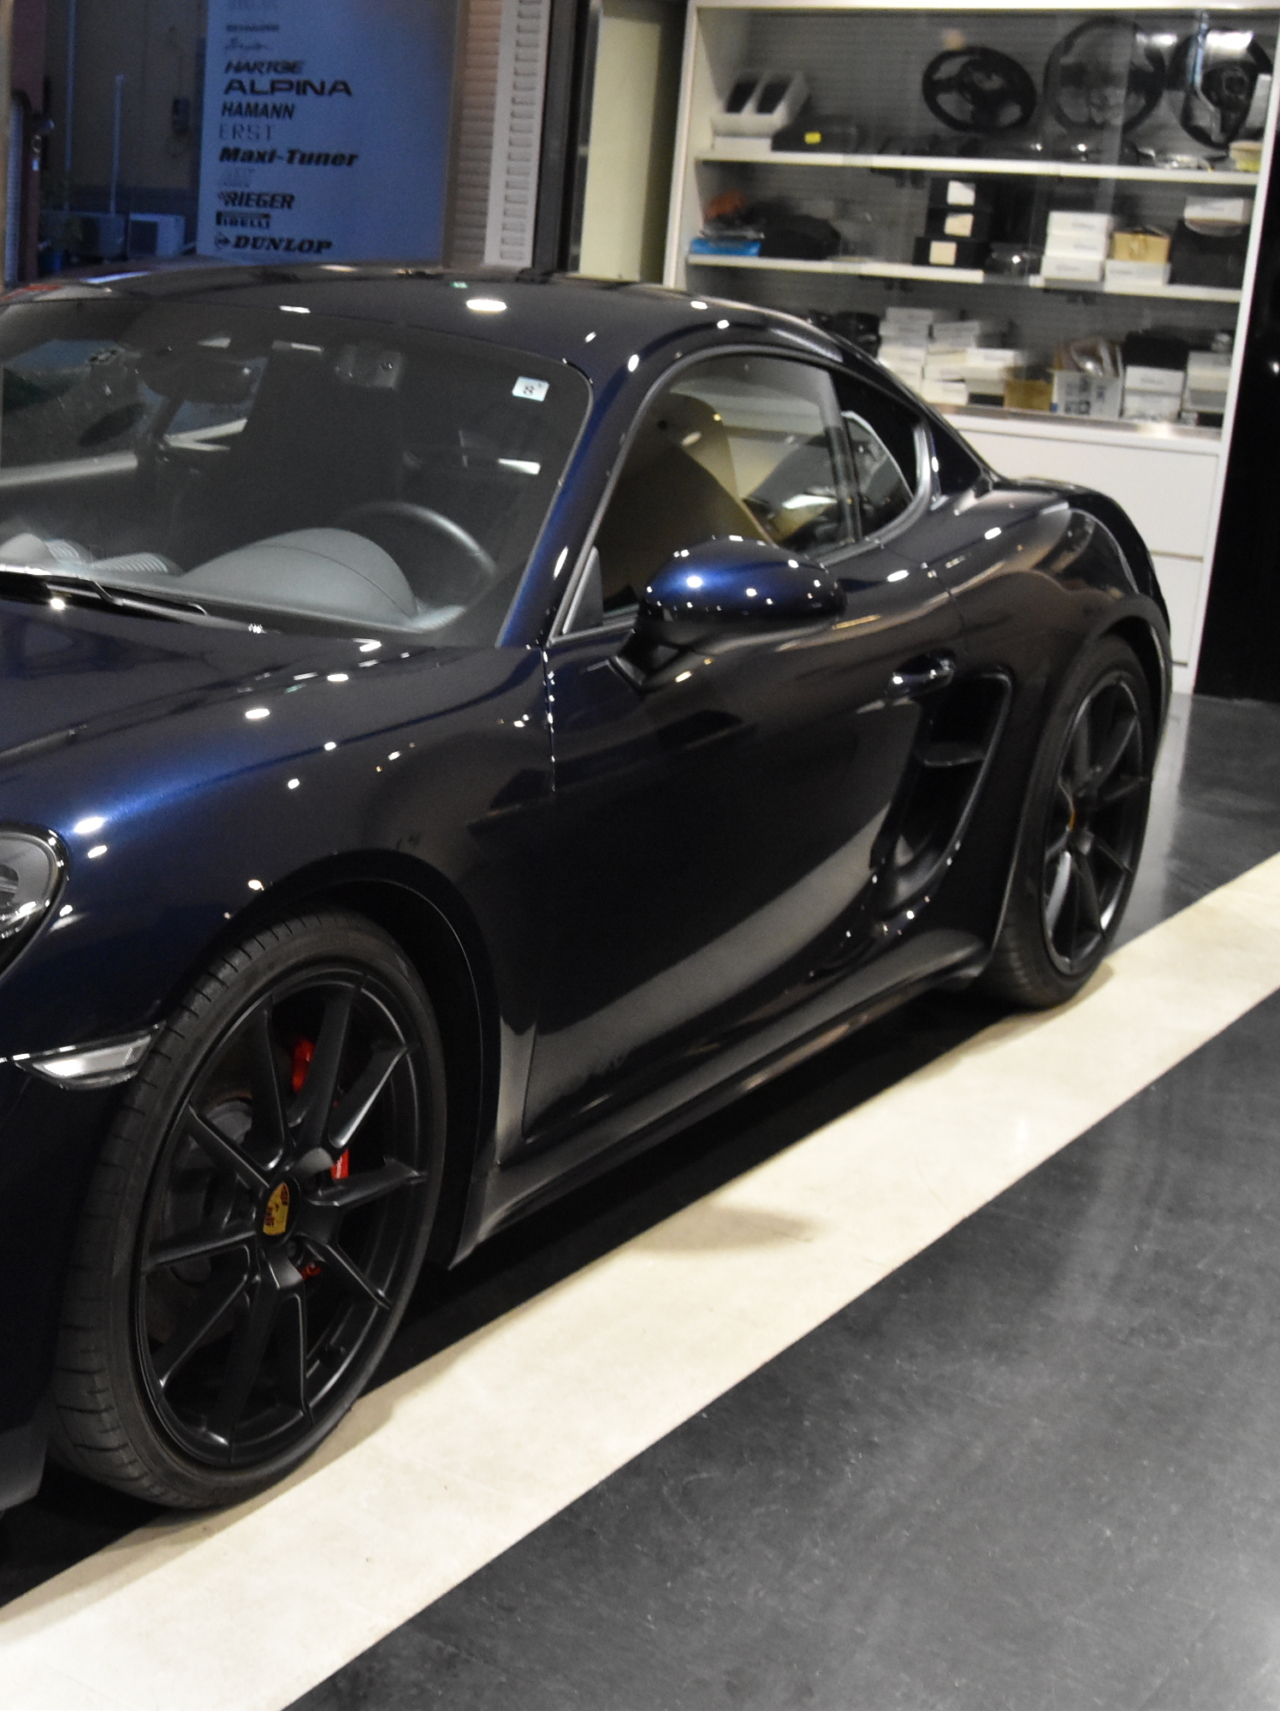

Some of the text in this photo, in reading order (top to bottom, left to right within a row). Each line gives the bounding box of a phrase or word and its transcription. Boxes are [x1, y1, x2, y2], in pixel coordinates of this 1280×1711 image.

[224, 79, 352, 96] ALPINA
[222, 101, 295, 119] HAMANN
[219, 123, 273, 140] ERST
[219, 147, 359, 166] Maxi-Tuner
[221, 190, 295, 209] RIEGER
[233, 235, 333, 253] DUNLOP
